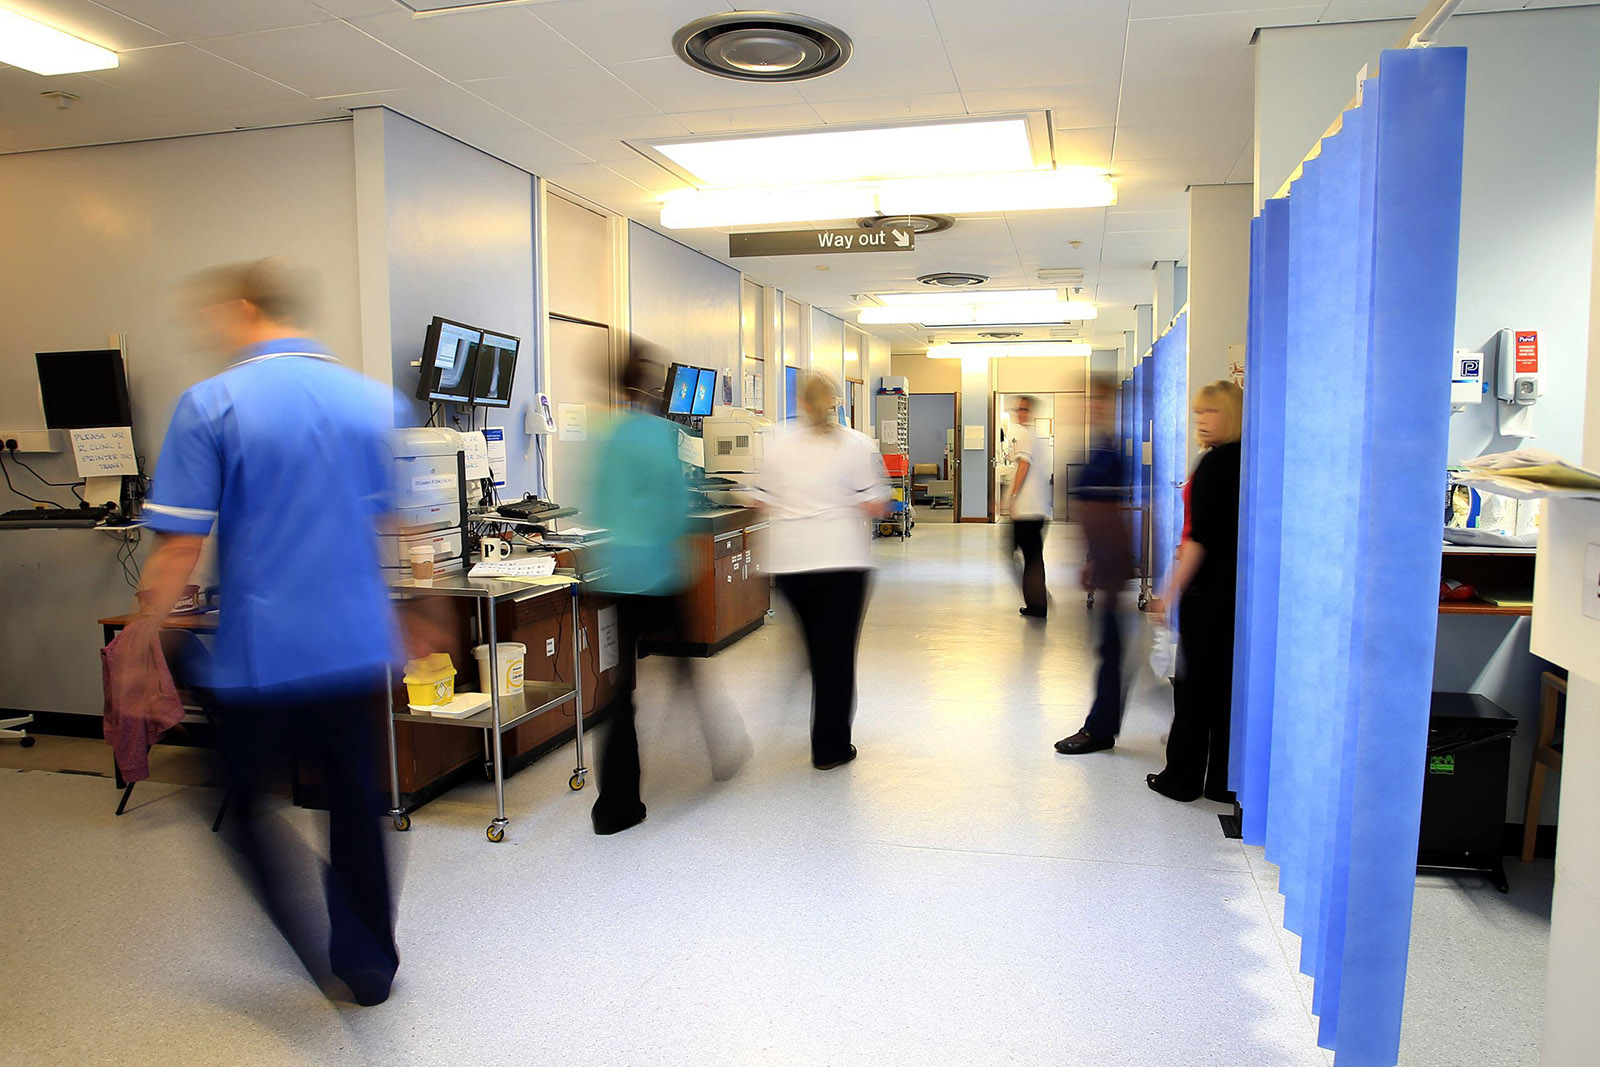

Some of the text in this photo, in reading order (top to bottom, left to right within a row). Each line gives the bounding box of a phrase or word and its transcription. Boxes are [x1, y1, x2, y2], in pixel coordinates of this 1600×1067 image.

[818, 230, 886, 249] Way out
[74, 433, 107, 441] PLEASE
[82, 454, 119, 462] PRINTER
[484, 544, 495, 557] P
